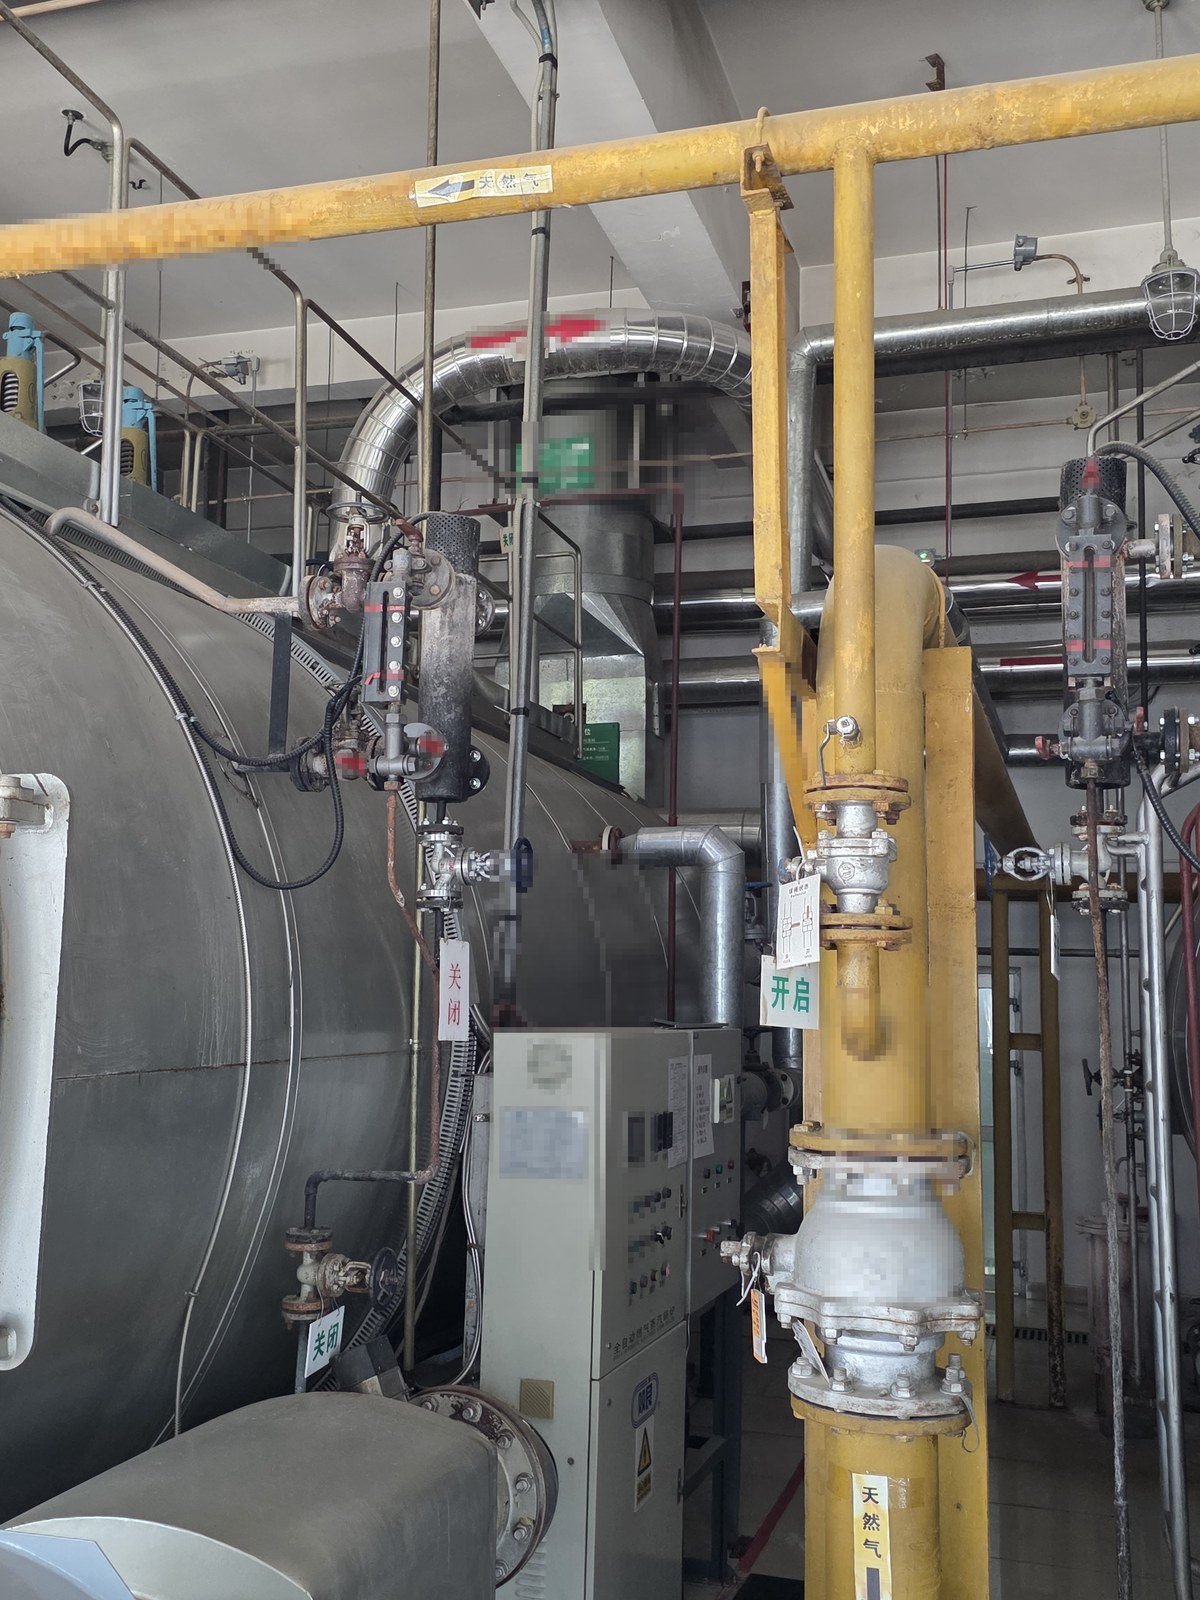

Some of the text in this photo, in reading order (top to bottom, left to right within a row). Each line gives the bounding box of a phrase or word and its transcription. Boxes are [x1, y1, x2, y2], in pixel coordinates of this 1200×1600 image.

[479, 173, 539, 190] 天然气
[447, 962, 462, 1026] 关闭
[771, 975, 810, 1013] 开启
[312, 1322, 339, 1361] 关闭
[862, 1486, 882, 1559] 天然气
